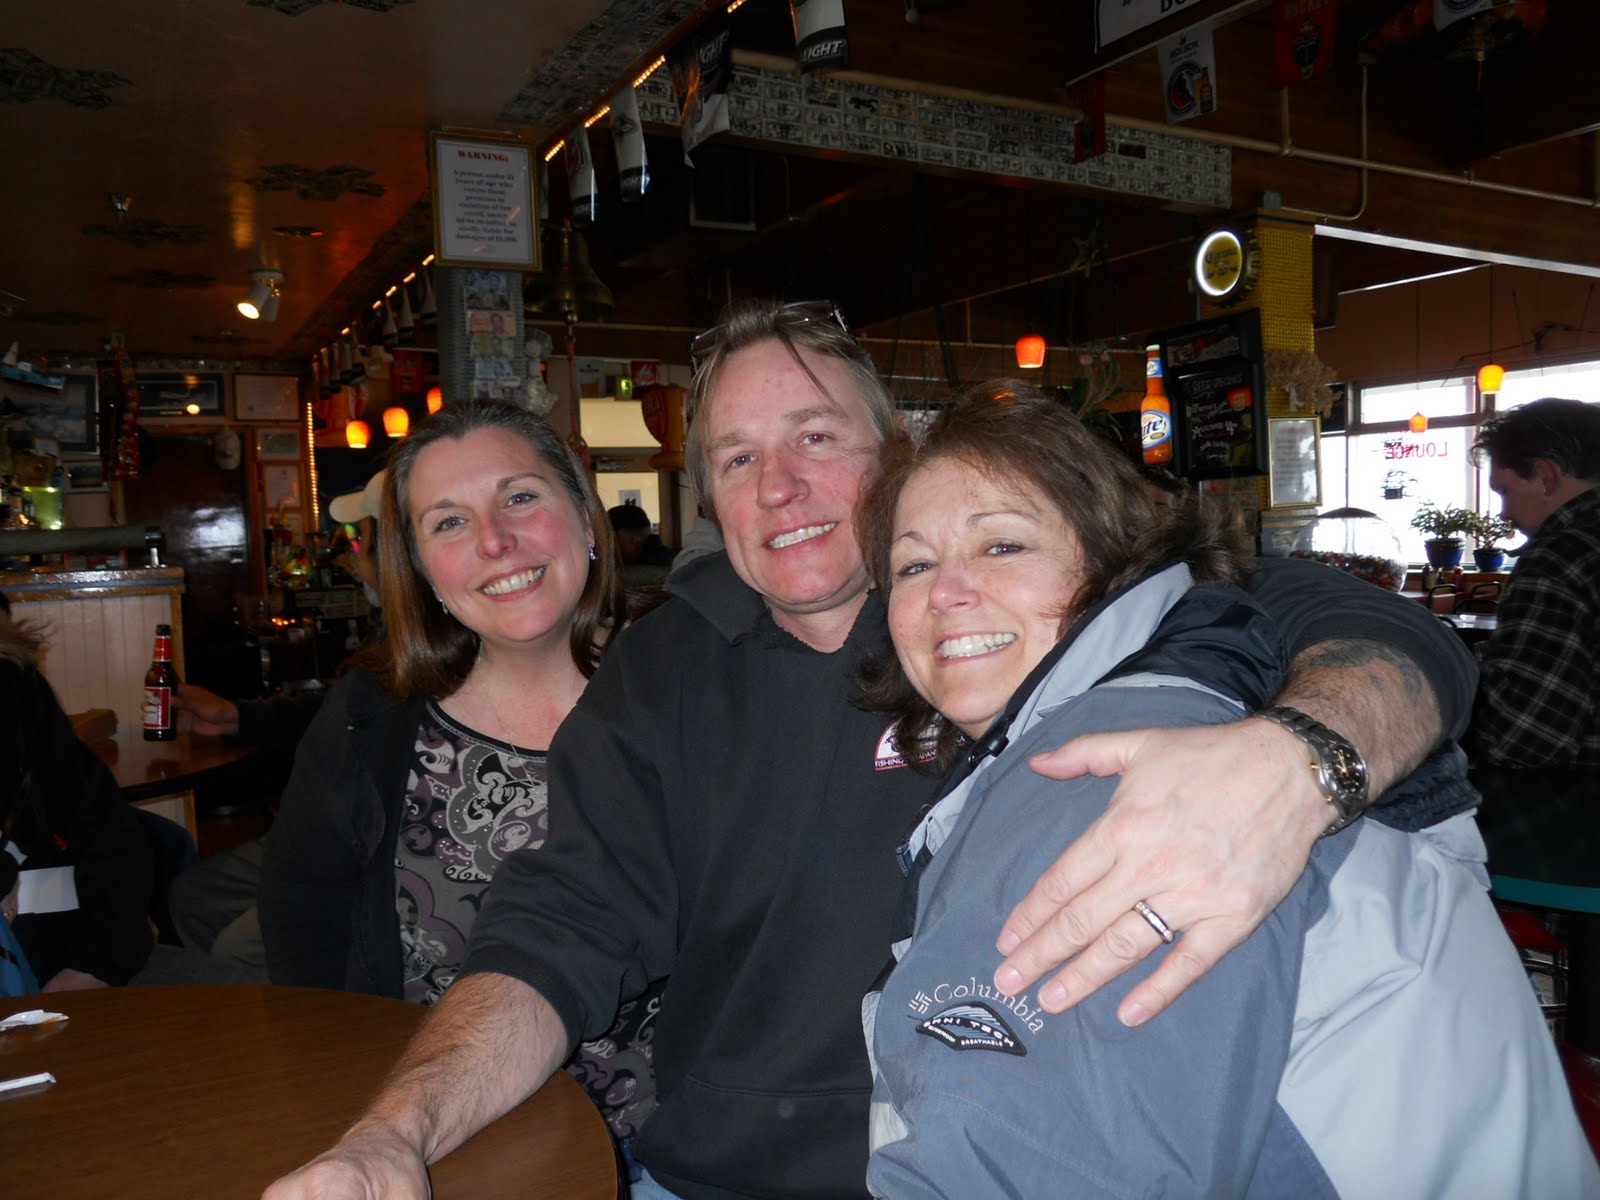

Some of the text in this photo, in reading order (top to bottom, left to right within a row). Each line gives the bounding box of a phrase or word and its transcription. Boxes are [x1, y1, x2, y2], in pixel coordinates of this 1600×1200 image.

[458, 150, 509, 162] WARNING:
[934, 977, 1044, 1035] Columbia
[961, 1039, 1003, 1047] BREATHABLE
